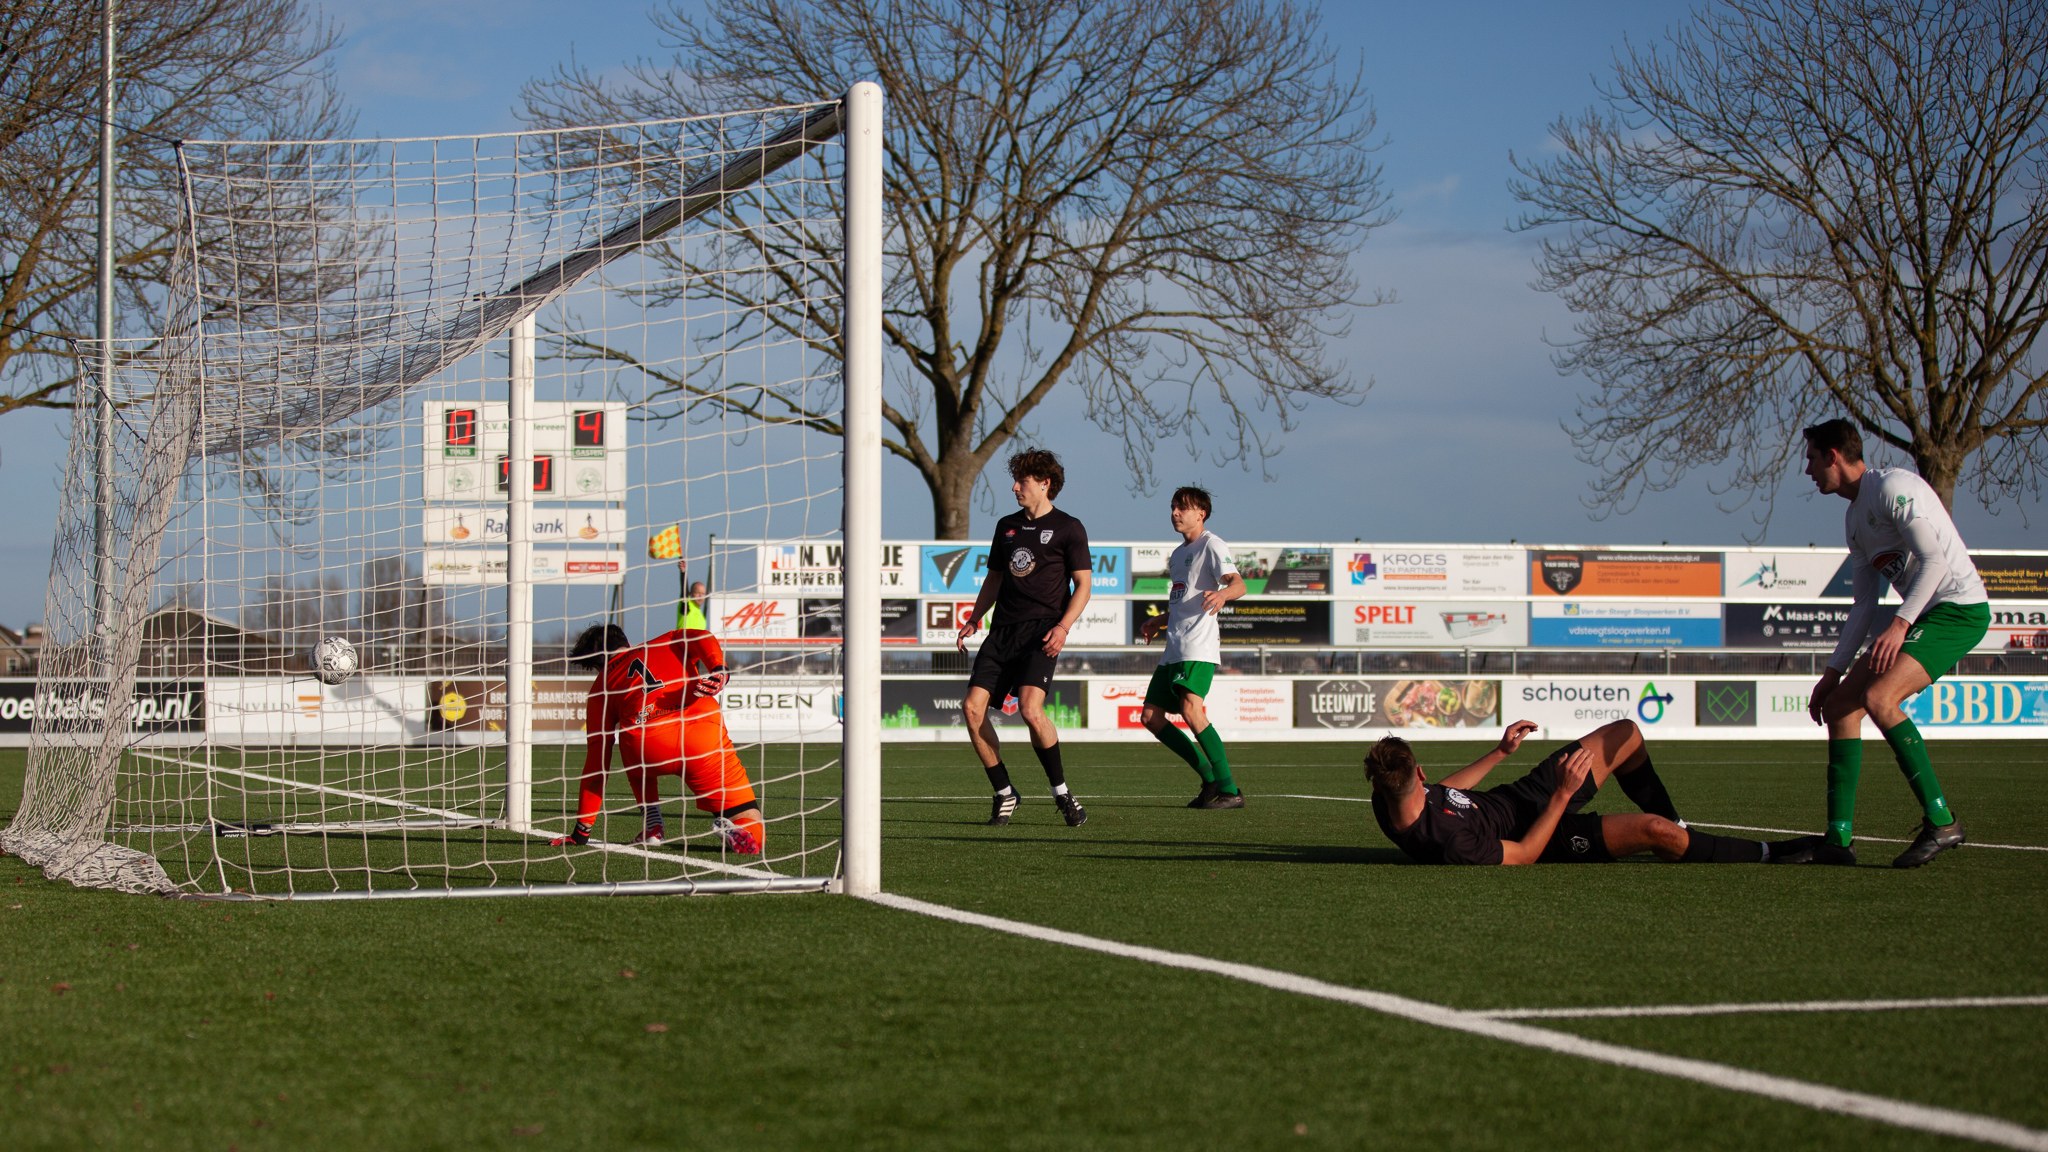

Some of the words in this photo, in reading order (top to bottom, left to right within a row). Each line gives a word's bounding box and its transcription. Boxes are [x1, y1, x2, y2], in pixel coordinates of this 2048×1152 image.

[448, 411, 474, 444] 0
[579, 412, 601, 444] 4
[1383, 554, 1447, 566] KROES
[1235, 606, 1306, 615] Installatietechniek
[1354, 605, 1417, 625] SPELT
[1568, 625, 1671, 637] vdsteegtsloopwerken.nl
[627, 658, 664, 693] 1
[1522, 682, 1630, 702] schouten
[933, 699, 962, 709] VINK
[1929, 682, 2023, 724] BBD
